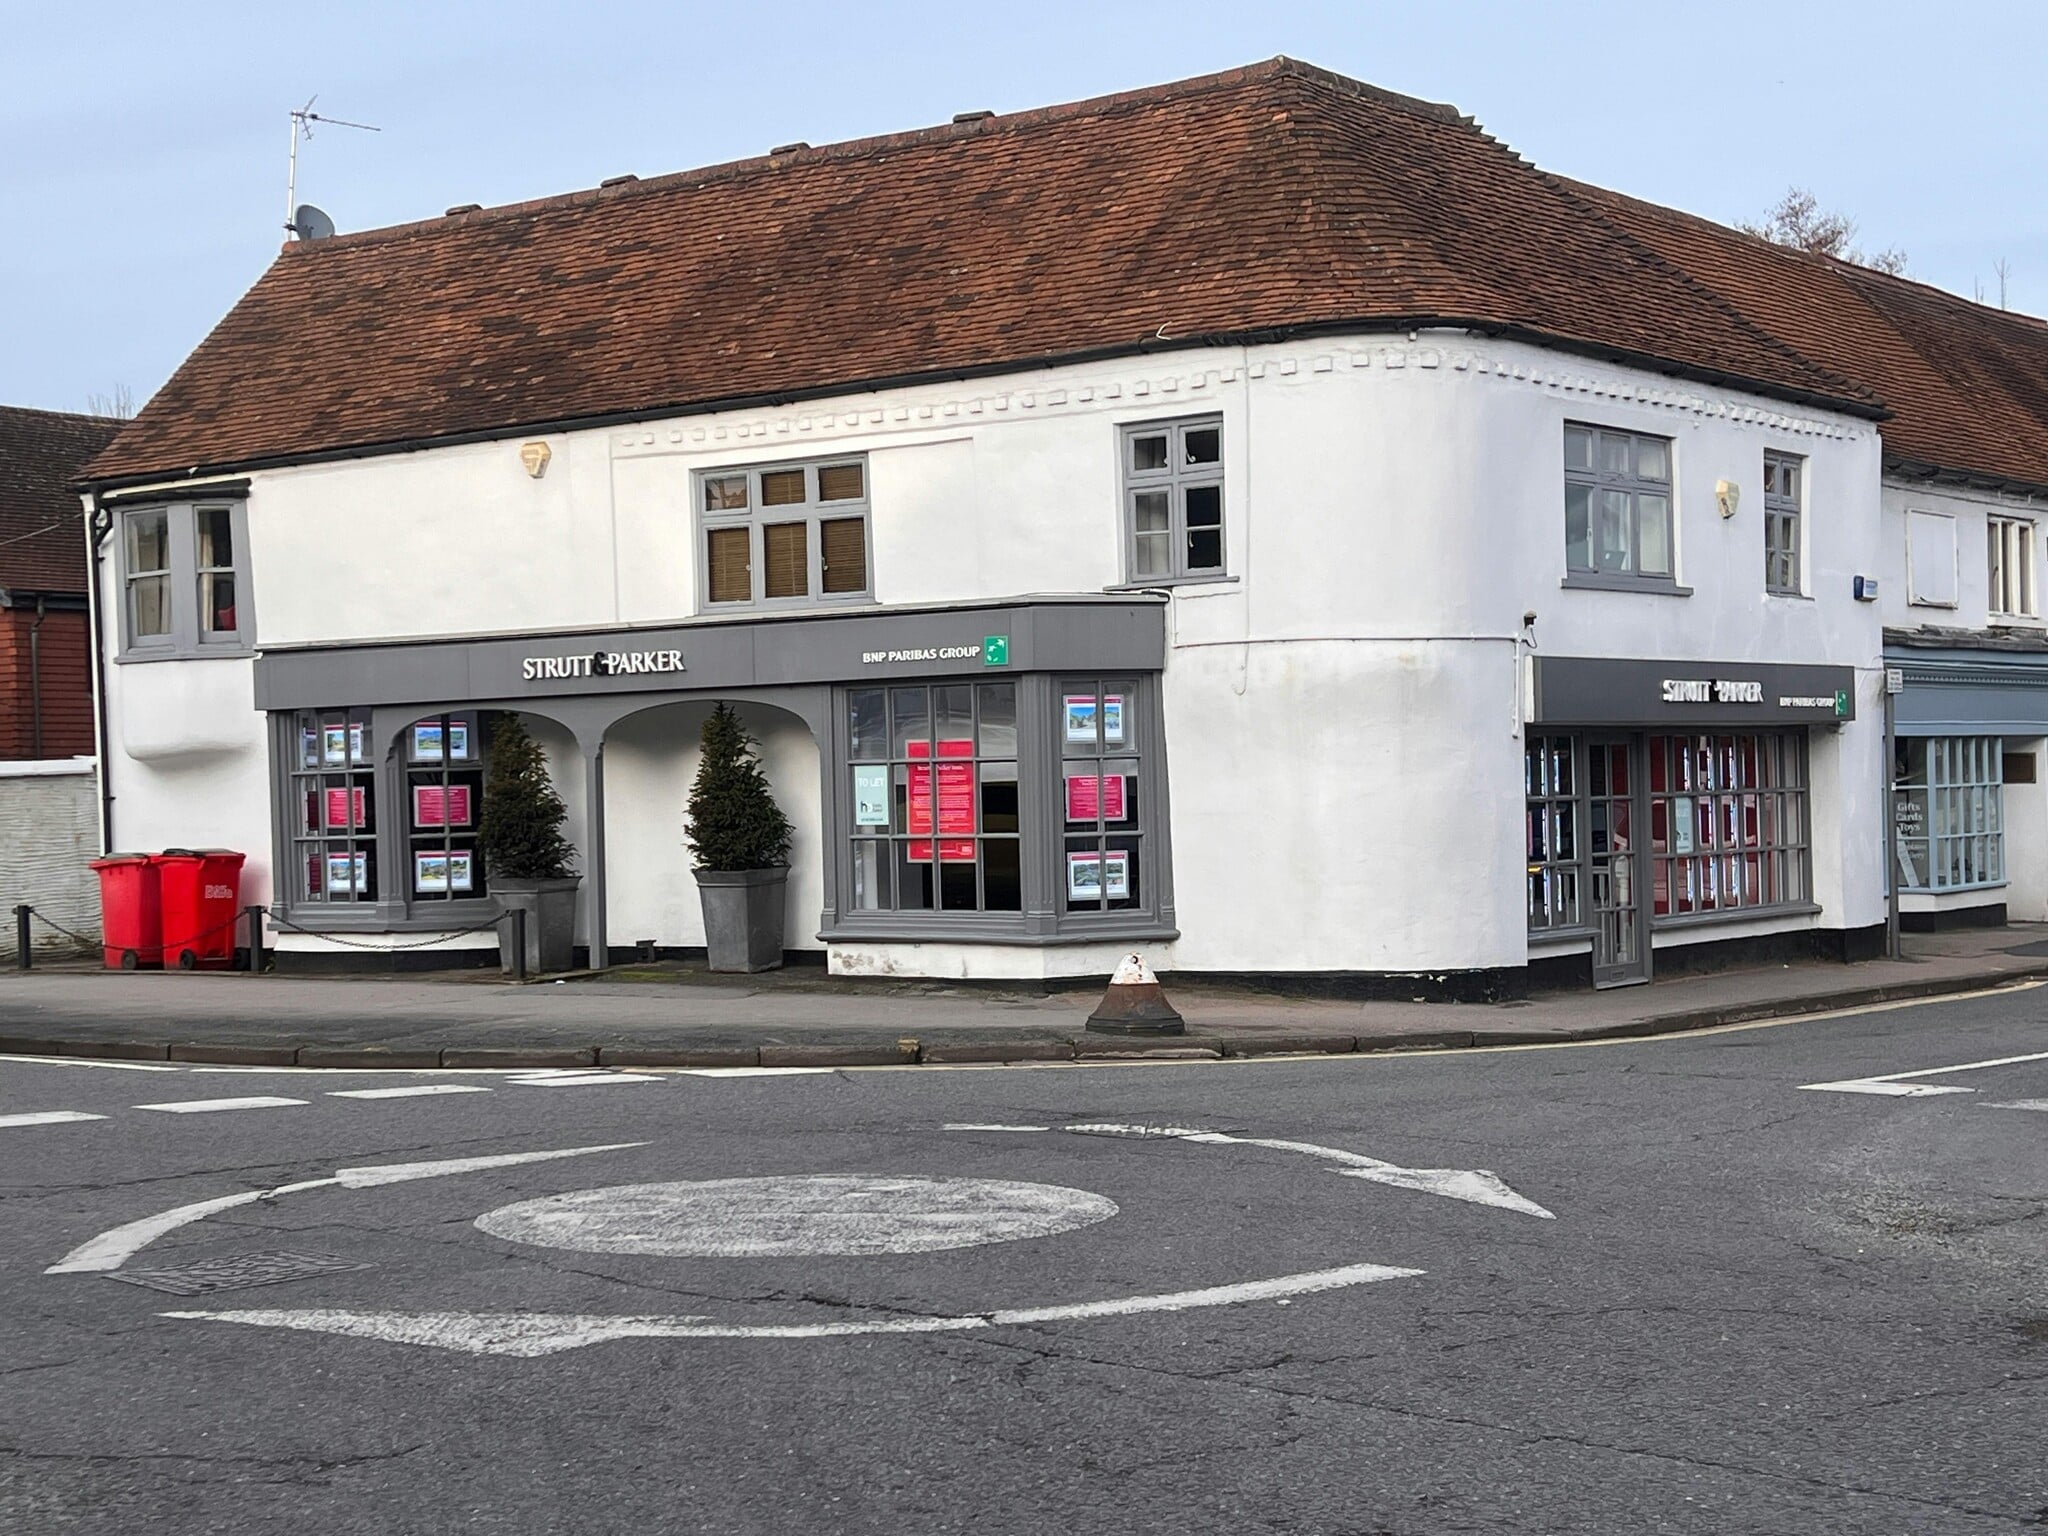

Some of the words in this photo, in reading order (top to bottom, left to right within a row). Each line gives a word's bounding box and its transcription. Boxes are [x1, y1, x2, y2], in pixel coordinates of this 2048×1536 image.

[862, 651, 887, 663] BNP
[888, 648, 937, 662] PARIBAS
[939, 646, 981, 659] GROUP
[1897, 802, 1921, 812] Gifts
[1898, 823, 1921, 834] Toys
